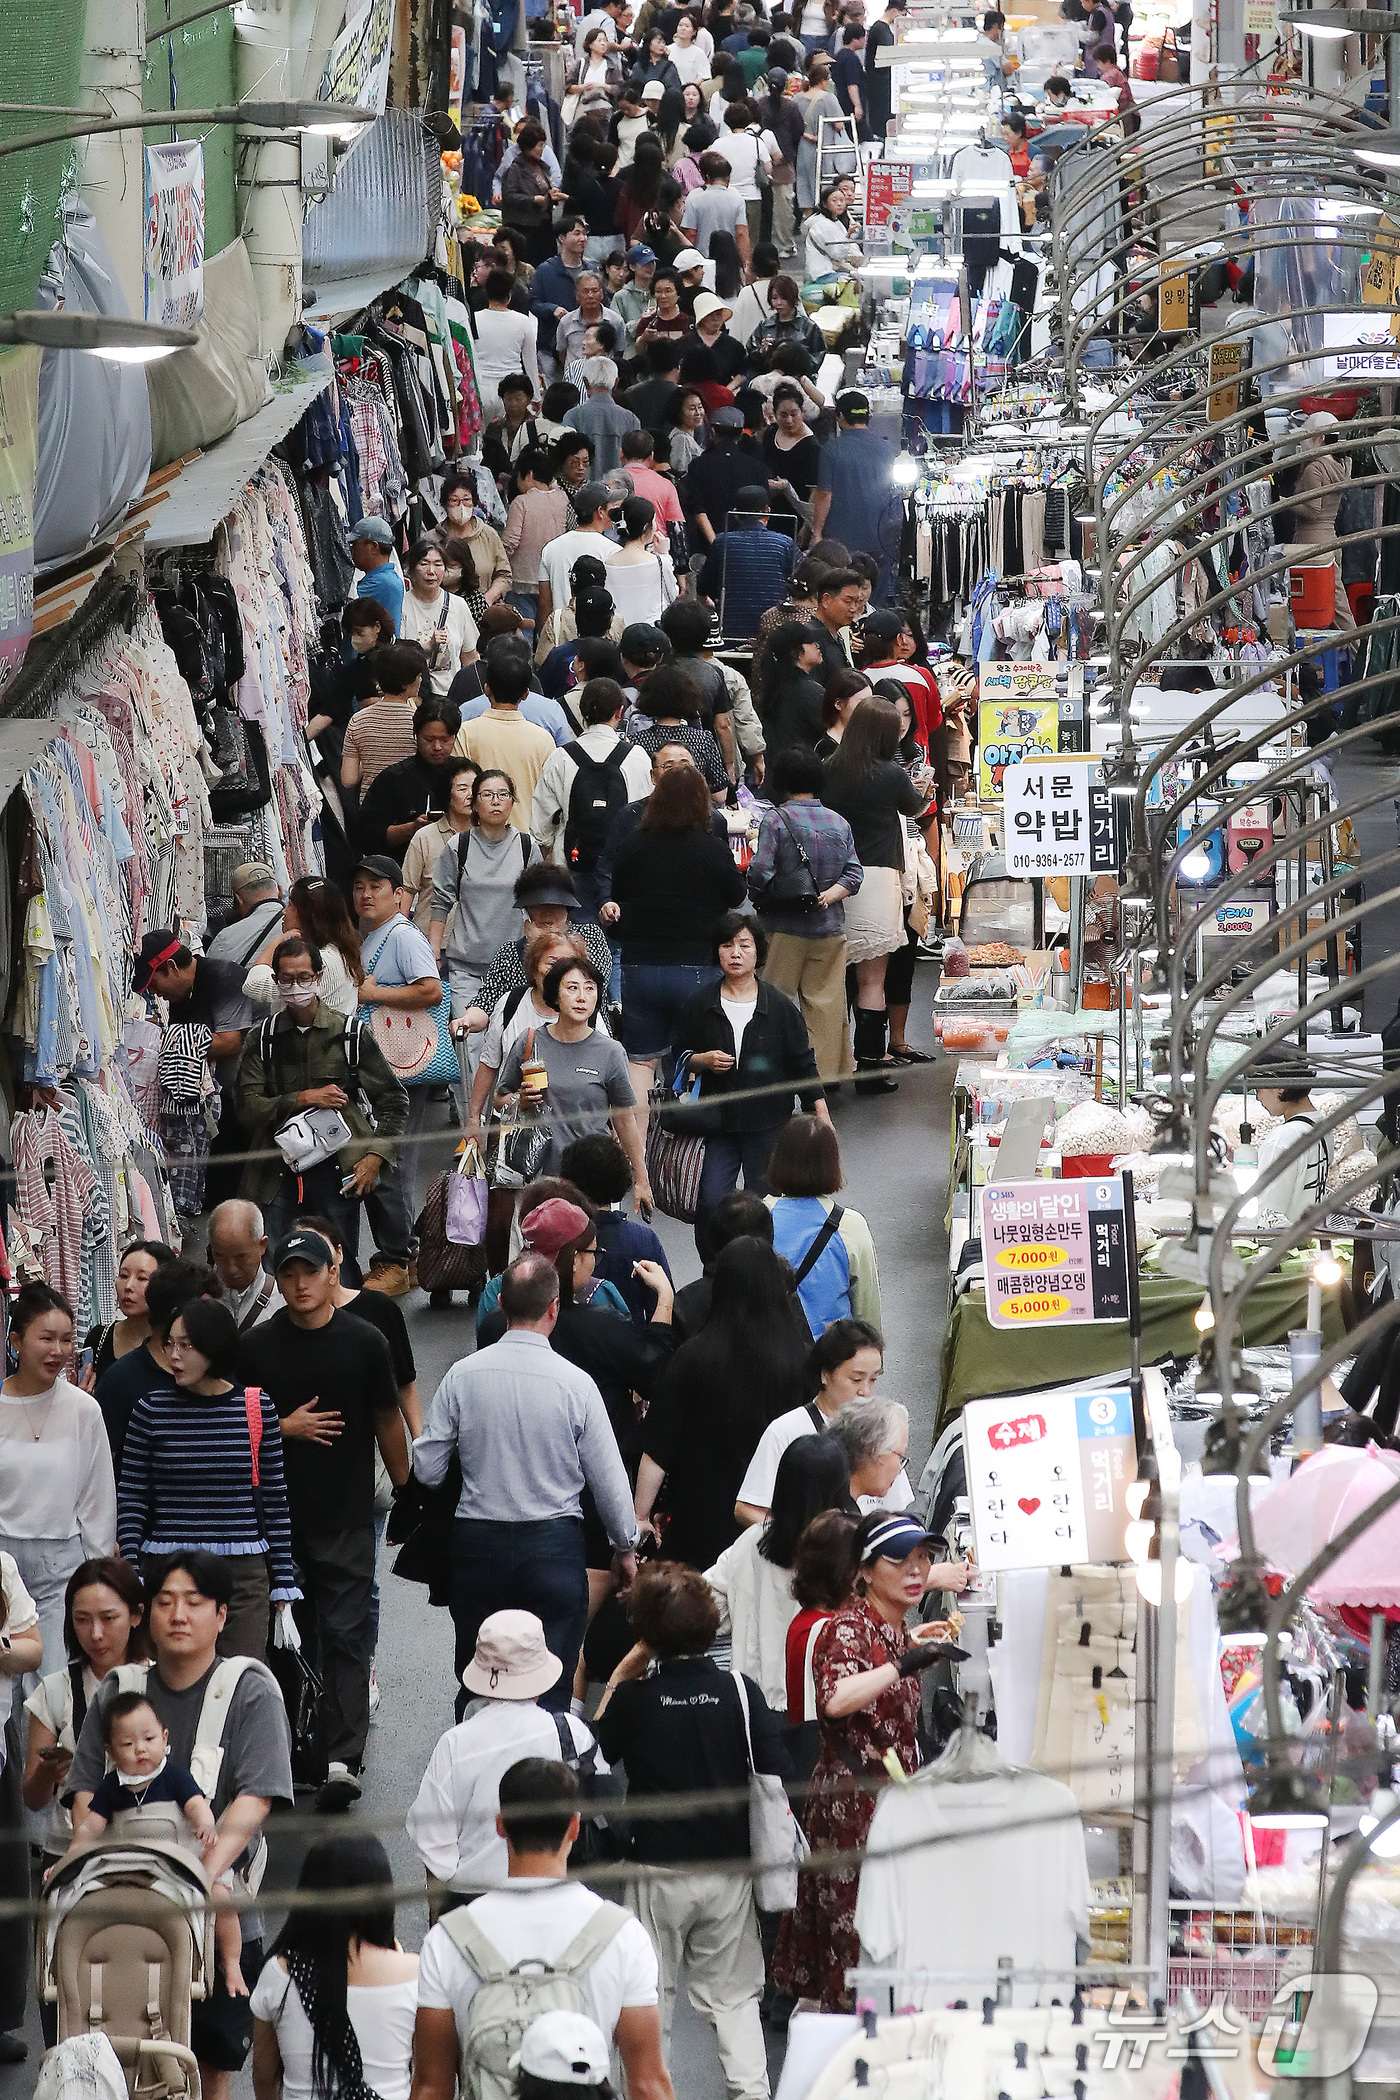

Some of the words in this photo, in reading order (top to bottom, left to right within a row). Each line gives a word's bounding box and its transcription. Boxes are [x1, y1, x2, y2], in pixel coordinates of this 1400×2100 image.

[1336, 355, 1400, 370] 날마다좋은
[1065, 704, 1071, 713] 3
[1022, 775, 1074, 800] 서문
[1014, 808, 1083, 842] 약밥
[1093, 793, 1115, 866] 먹거리
[1013, 853, 1085, 868] 010-9364-2577
[1000, 1190, 1015, 1199] SBS
[1100, 1188, 1107, 1199] 3
[990, 1199, 1038, 1222] 생활의
[1039, 1192, 1081, 1219] 달인
[1111, 1223, 1119, 1245] Food
[1095, 1223, 1111, 1268] 먹거리
[1097, 1402, 1109, 1419] 3
[1090, 1448, 1115, 1513] 먹거리
